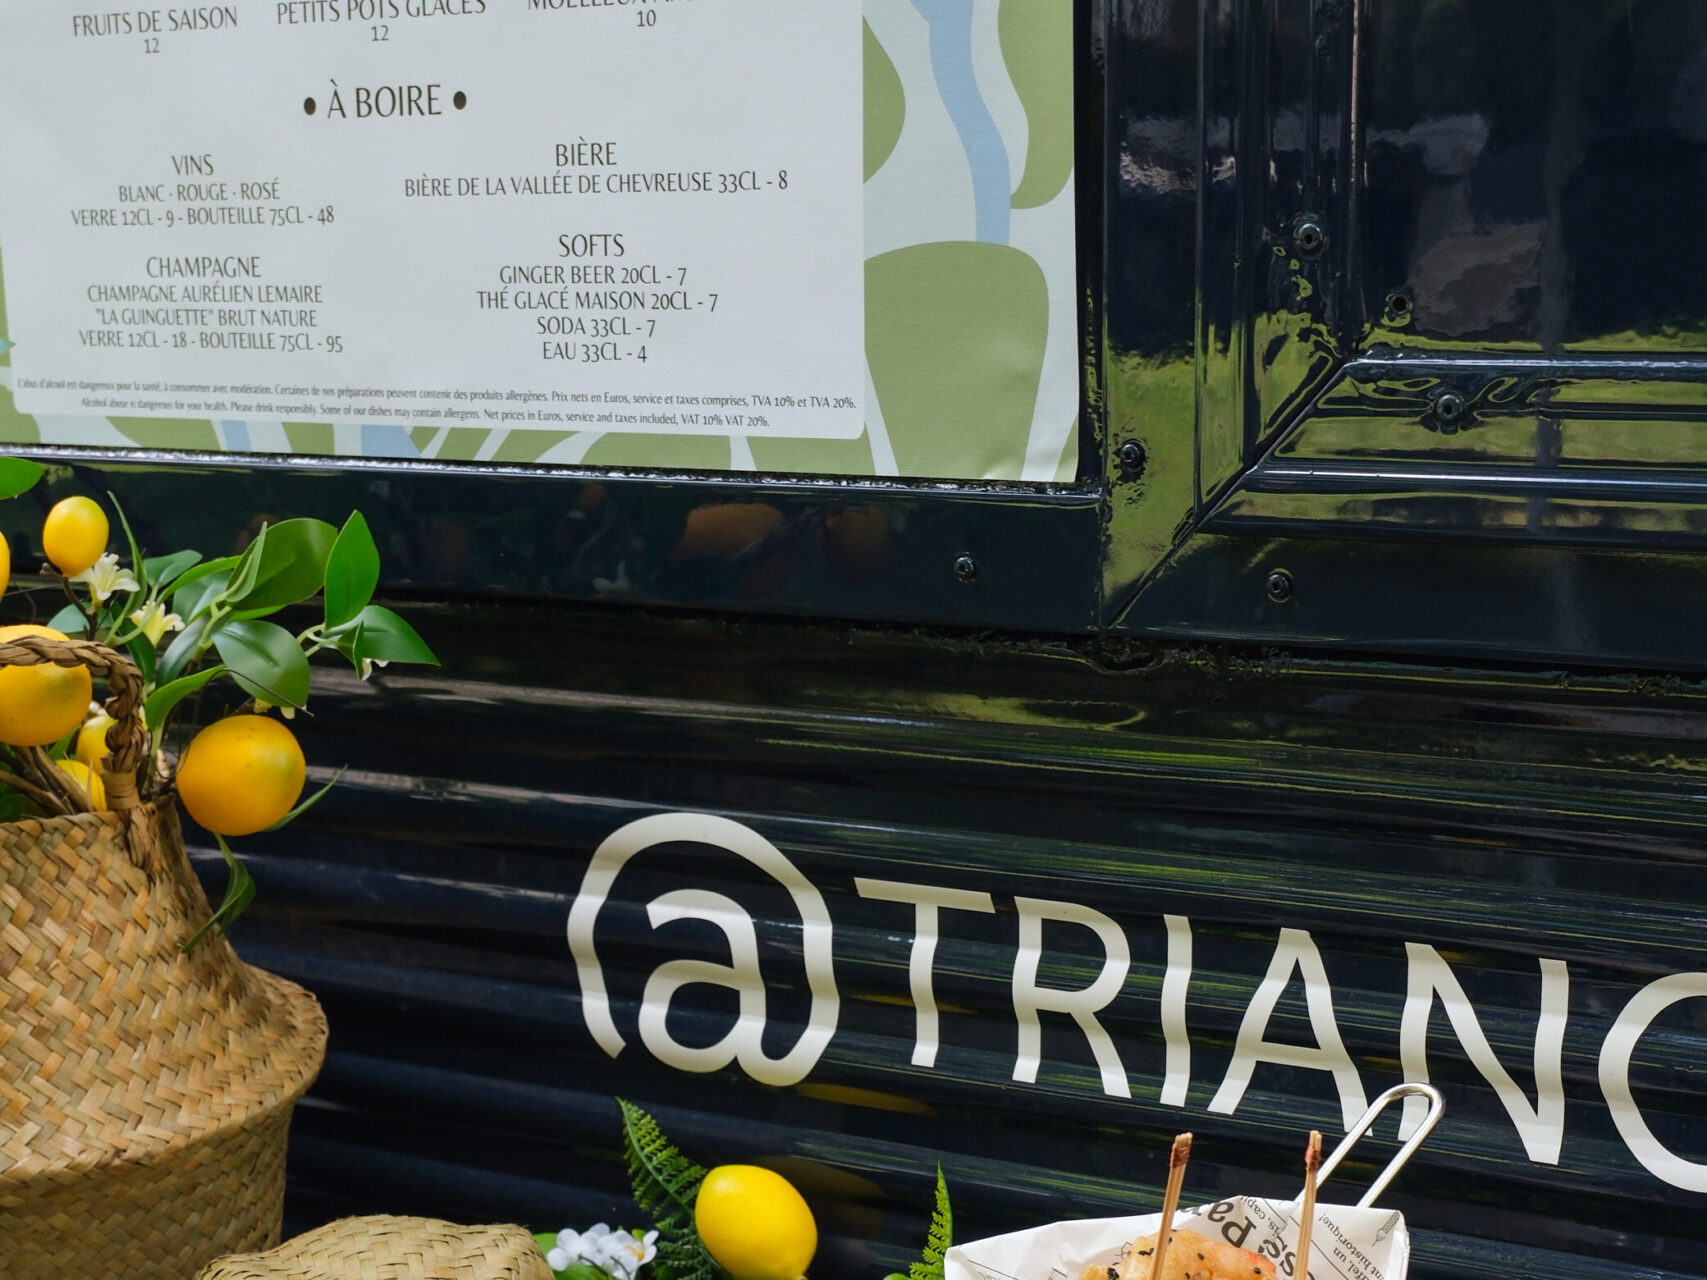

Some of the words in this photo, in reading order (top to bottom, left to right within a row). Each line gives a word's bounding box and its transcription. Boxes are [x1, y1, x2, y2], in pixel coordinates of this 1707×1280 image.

[73, 12, 132, 36] FRUITS
[138, 10, 162, 33] DE
[168, 6, 237, 31] SAISON
[277, 0, 340, 24] PETITS
[347, 0, 399, 20] POTS
[637, 9, 656, 27] 10
[371, 25, 389, 41] 12
[144, 38, 160, 54] 12
[327, 78, 347, 119] À
[355, 84, 442, 118] BOIRE
[556, 136, 617, 167] BIÈRE
[171, 154, 214, 176] VINS
[119, 184, 164, 202] BLANC
[177, 183, 228, 201] ROUGE
[241, 177, 280, 200] ROSÉ
[405, 173, 452, 197] BIÈRE
[458, 178, 480, 196] DE
[486, 177, 506, 195] LA
[510, 170, 572, 194] VALLÉE
[579, 175, 601, 193] DE
[606, 172, 712, 193] CHEVREUSE
[718, 171, 761, 193] 33CL
[779, 170, 787, 190] 8
[71, 209, 117, 226] VERRE
[122, 208, 154, 226] 12CL
[166, 210, 174, 227] 9
[187, 206, 265, 225] BOUTEILLE
[269, 206, 304, 226] 75CL
[317, 205, 334, 225] 48
[559, 234, 624, 257] SOFTS
[147, 256, 261, 278] CHAMPAGNE
[500, 266, 565, 284] GINGER
[571, 266, 615, 284] BEER
[621, 265, 661, 284] 20CL
[677, 268, 687, 286] 7
[88, 285, 177, 302] CHAMPAGNE
[182, 280, 253, 302] AURÉLIEN
[258, 285, 323, 303] LEMAIRE
[476, 286, 509, 309] THÉ
[514, 285, 569, 309] GLACÉ
[576, 291, 645, 310] MAISON
[651, 291, 692, 310] 20CL
[709, 294, 718, 312] 7
[96, 308, 118, 324] "LA
[122, 309, 213, 325] GUINGUETTE"
[218, 309, 256, 326] BRUT
[261, 310, 317, 327] NATURE
[537, 316, 586, 334] SODA
[591, 316, 631, 337] 33CL
[646, 320, 656, 338] 7
[79, 330, 124, 347] VERRE
[129, 331, 159, 347] 12CL
[172, 331, 187, 348] 18
[200, 332, 275, 349] BOUTEILLE
[280, 333, 313, 352] 75CL
[326, 336, 343, 353] 95
[543, 342, 576, 360] EAU
[582, 342, 622, 363] 33CL
[637, 345, 647, 363] 4
[453, 388, 468, 398] des
[470, 389, 503, 401] produits
[505, 390, 549, 402] allergènes.
[552, 391, 568, 401] Prix
[571, 391, 589, 401] nets
[604, 392, 631, 405] Euros,
[633, 393, 662, 403] service
[676, 394, 700, 404] taxes
[702, 394, 749, 408] comprises,
[752, 395, 772, 406] TVA
[774, 396, 794, 407] 10%
[809, 397, 830, 407] TVA
[833, 397, 856, 408] 20%.
[443, 408, 481, 421] allergens.
[484, 409, 499, 419] Net
[501, 410, 526, 422] prices
[538, 411, 564, 423] Euros,
[566, 412, 595, 422] service
[597, 412, 613, 422] and
[615, 413, 637, 423] taxes
[640, 414, 678, 426] included,
[681, 414, 700, 425] VAT
[702, 415, 723, 425] 10%
[725, 416, 745, 426] VAT
[747, 416, 770, 426] 20%.
[1318, 1213, 1371, 1269] historique!
[1333, 1247, 1347, 1263] un
